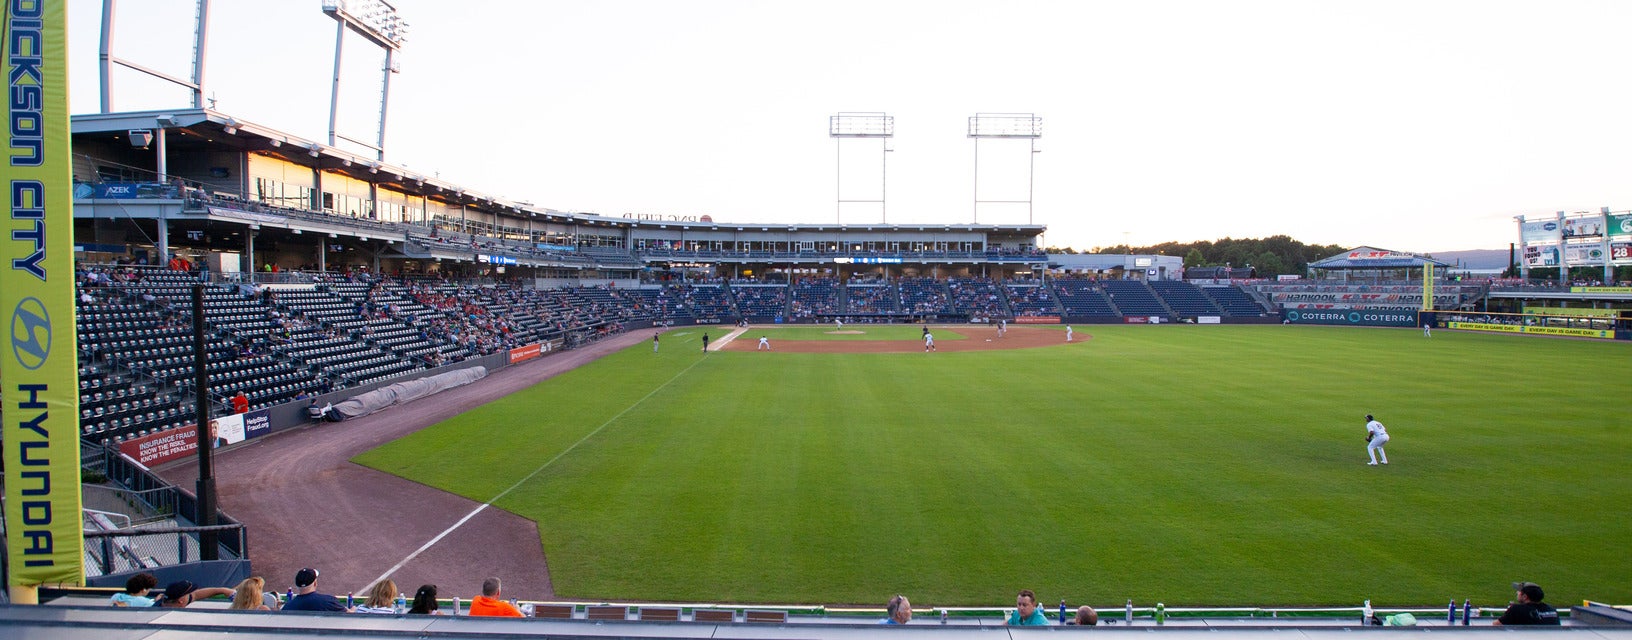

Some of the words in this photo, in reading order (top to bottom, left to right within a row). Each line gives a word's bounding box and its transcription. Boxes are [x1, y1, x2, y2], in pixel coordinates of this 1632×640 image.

[10, 0, 45, 166] DICKSON
[105, 186, 130, 197] AZEK
[11, 180, 47, 281] CITY
[1613, 247, 1628, 257] 28
[1363, 314, 1414, 322] COTERRA
[246, 416, 268, 425] HelpStop
[247, 422, 270, 431] Fraud.org
[139, 435, 175, 450] INSURANCE
[175, 430, 196, 440] FRAUD
[140, 447, 158, 457] KNOW
[169, 439, 186, 448] RISKS.
[140, 453, 159, 463] KNOW
[159, 449, 170, 457] THE
[18, 384, 54, 567] HYUNDAI
